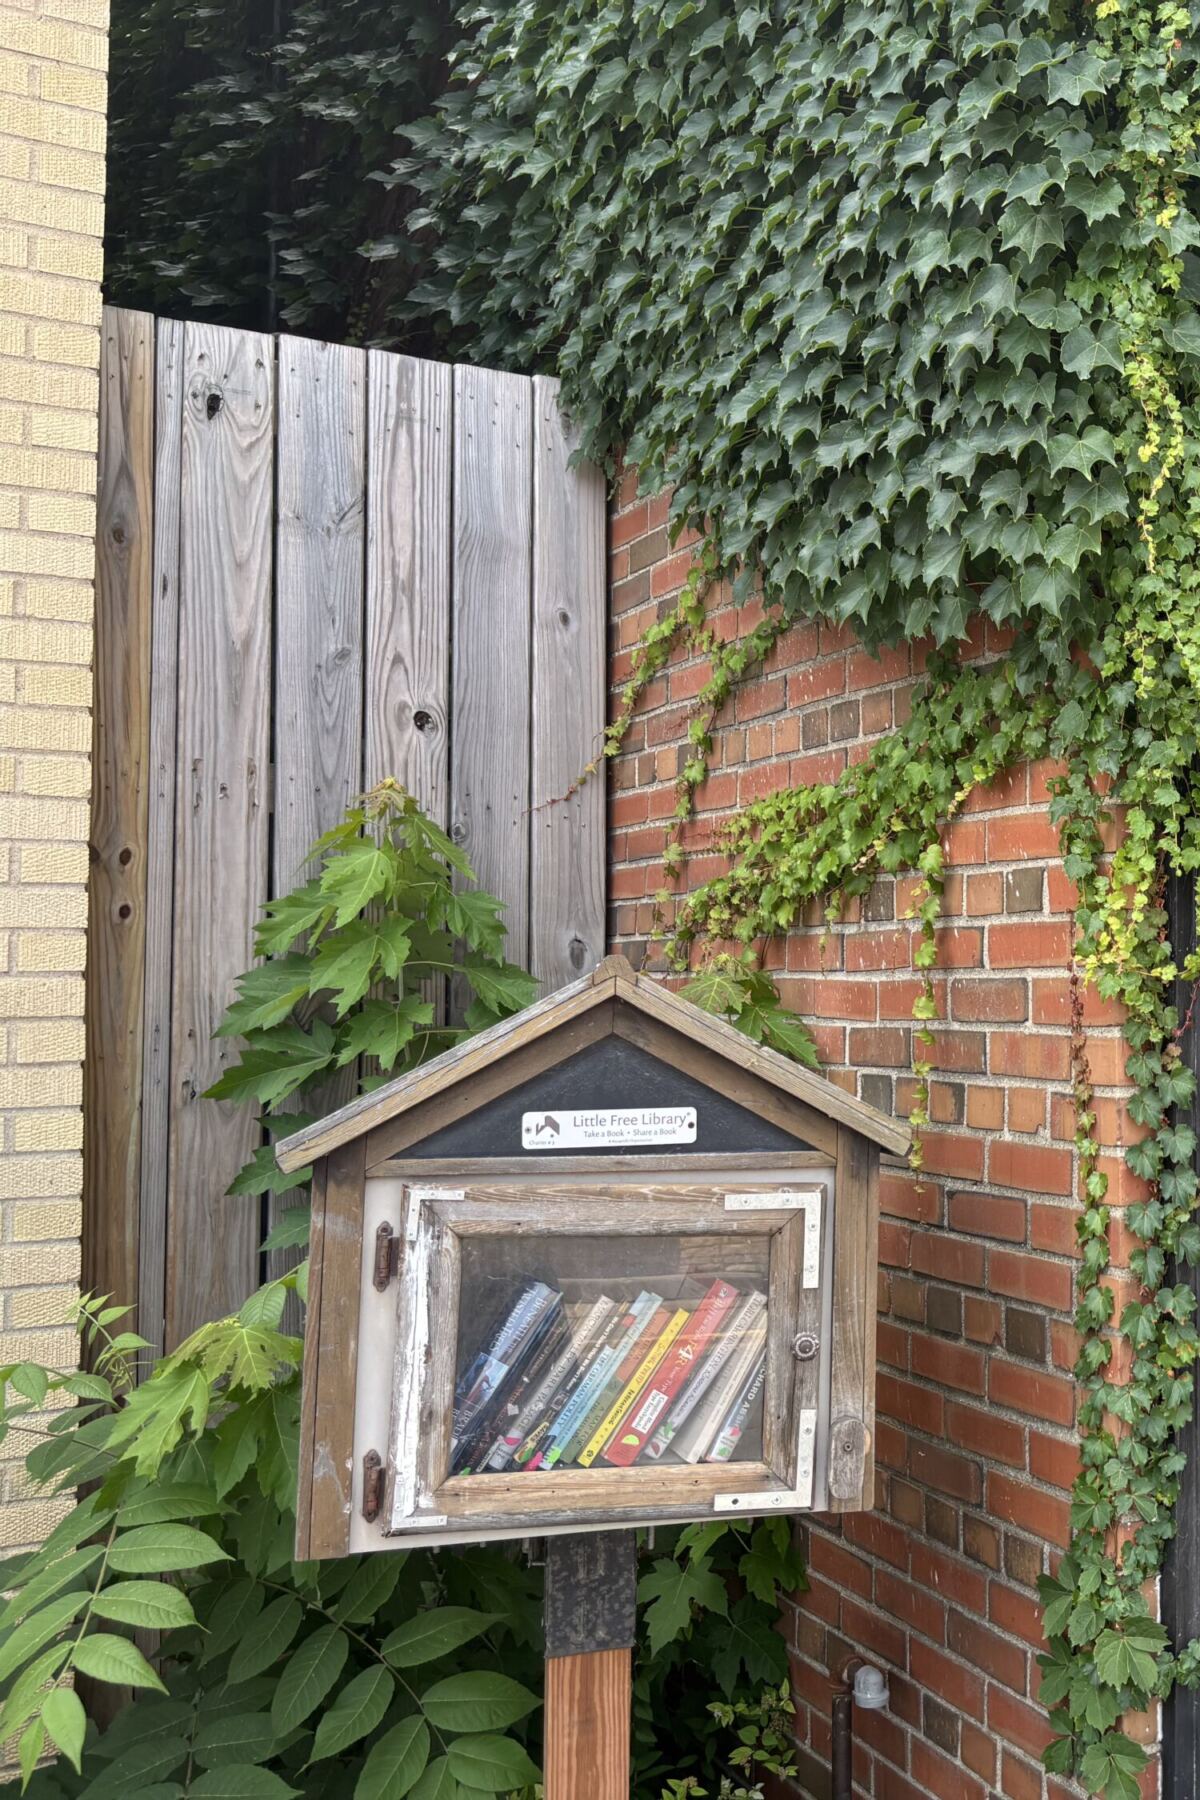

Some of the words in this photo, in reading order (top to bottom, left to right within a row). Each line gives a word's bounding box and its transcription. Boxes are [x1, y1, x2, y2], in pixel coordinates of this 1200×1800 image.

[573, 1114, 607, 1128] Little
[610, 1114, 638, 1126] Free
[583, 1130, 600, 1138] Take
[606, 1128, 624, 1137] Book
[633, 1128, 653, 1137] Share
[659, 1127, 677, 1136] Book
[510, 1295, 546, 1342] BENEATH
[488, 1324, 512, 1354] TREES
[544, 1364, 566, 1392] DARK
[574, 1367, 598, 1399] GERMAN
[746, 1362, 769, 1400] CHARD
[556, 1398, 578, 1427] POLITY
